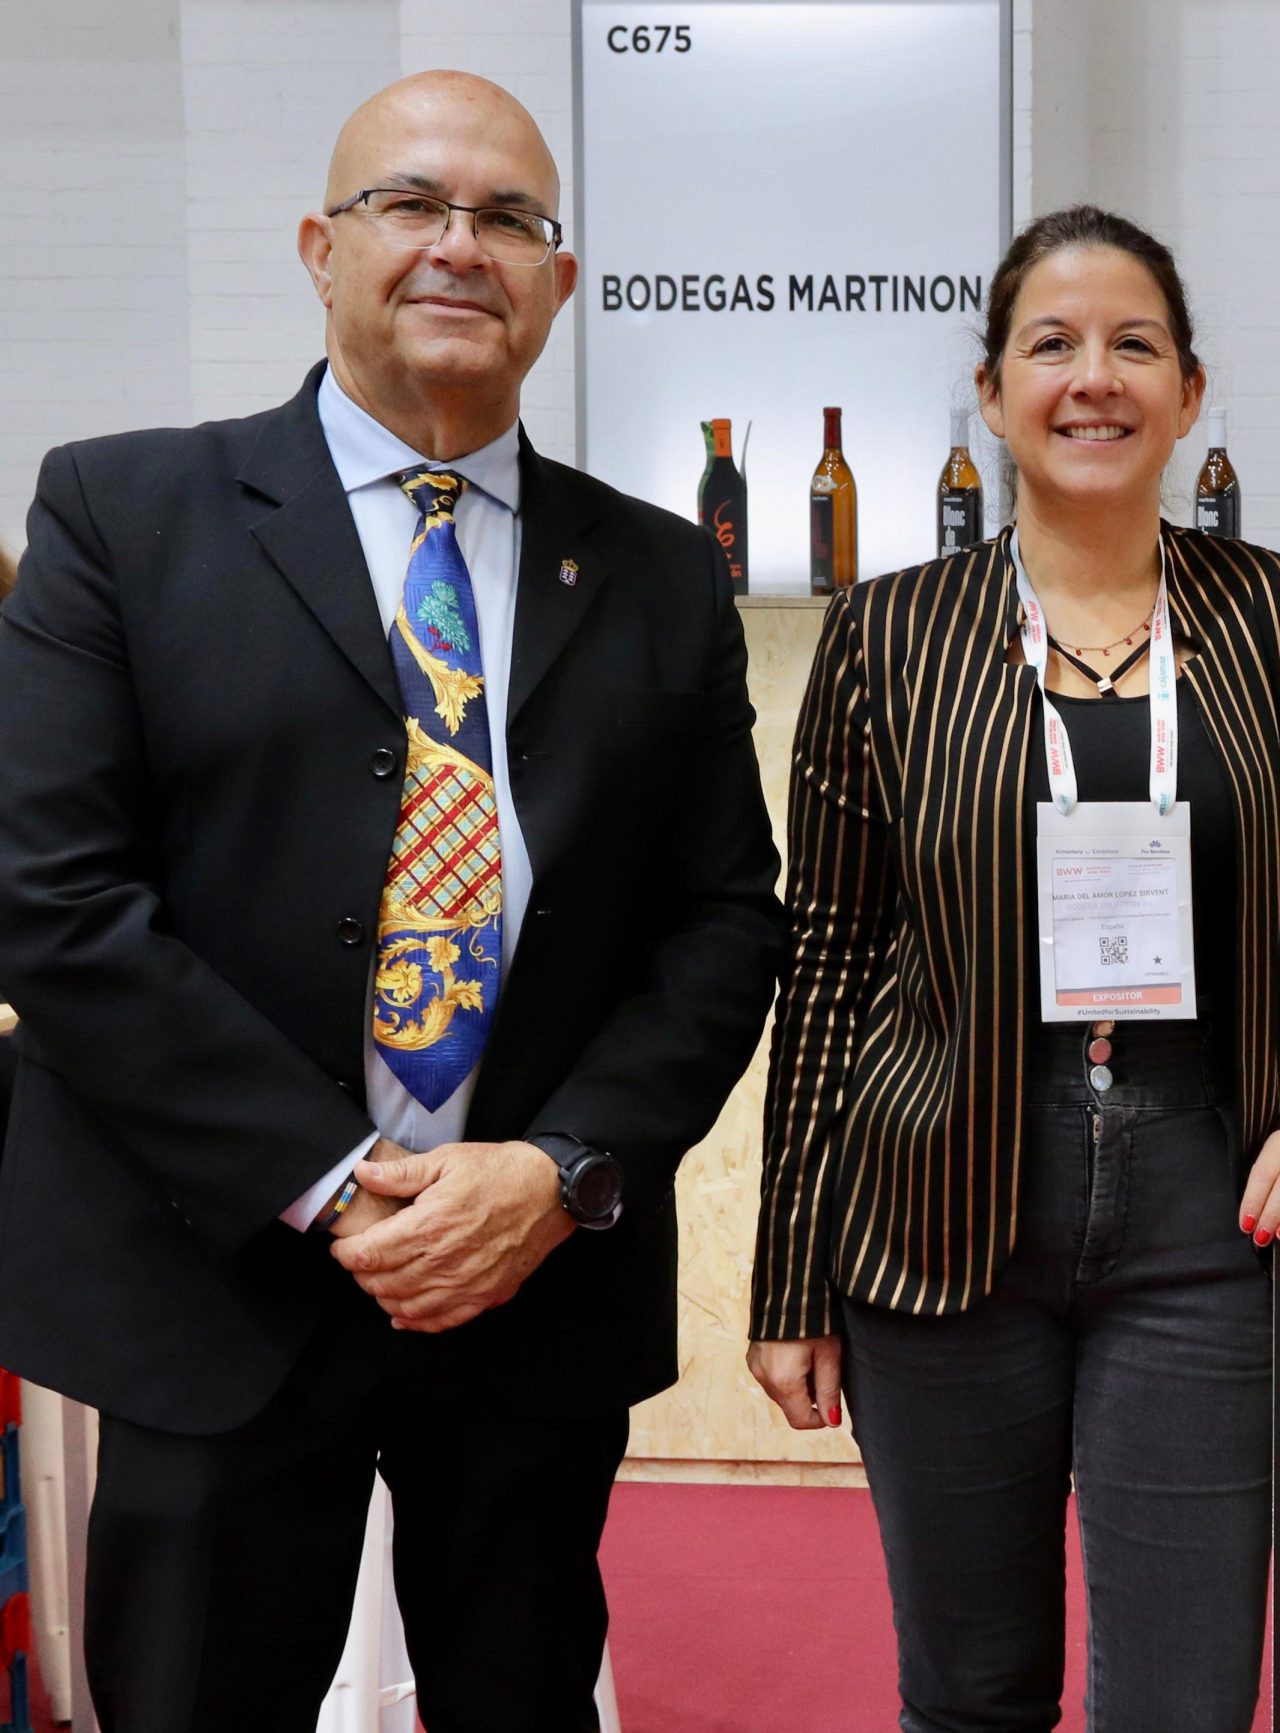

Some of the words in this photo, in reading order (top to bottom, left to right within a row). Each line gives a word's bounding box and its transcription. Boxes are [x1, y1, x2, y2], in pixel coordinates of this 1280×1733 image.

[607, 25, 692, 53] C675
[602, 274, 775, 312] BODEGAS
[788, 275, 982, 312] MARTINON
[1052, 748, 1062, 776] BWW
[1156, 747, 1165, 773] BWW
[1056, 867, 1083, 876] BWW
[1093, 991, 1143, 1002] EXPOSITOR
[1077, 1007, 1161, 1016] #UnitedforSustainability
